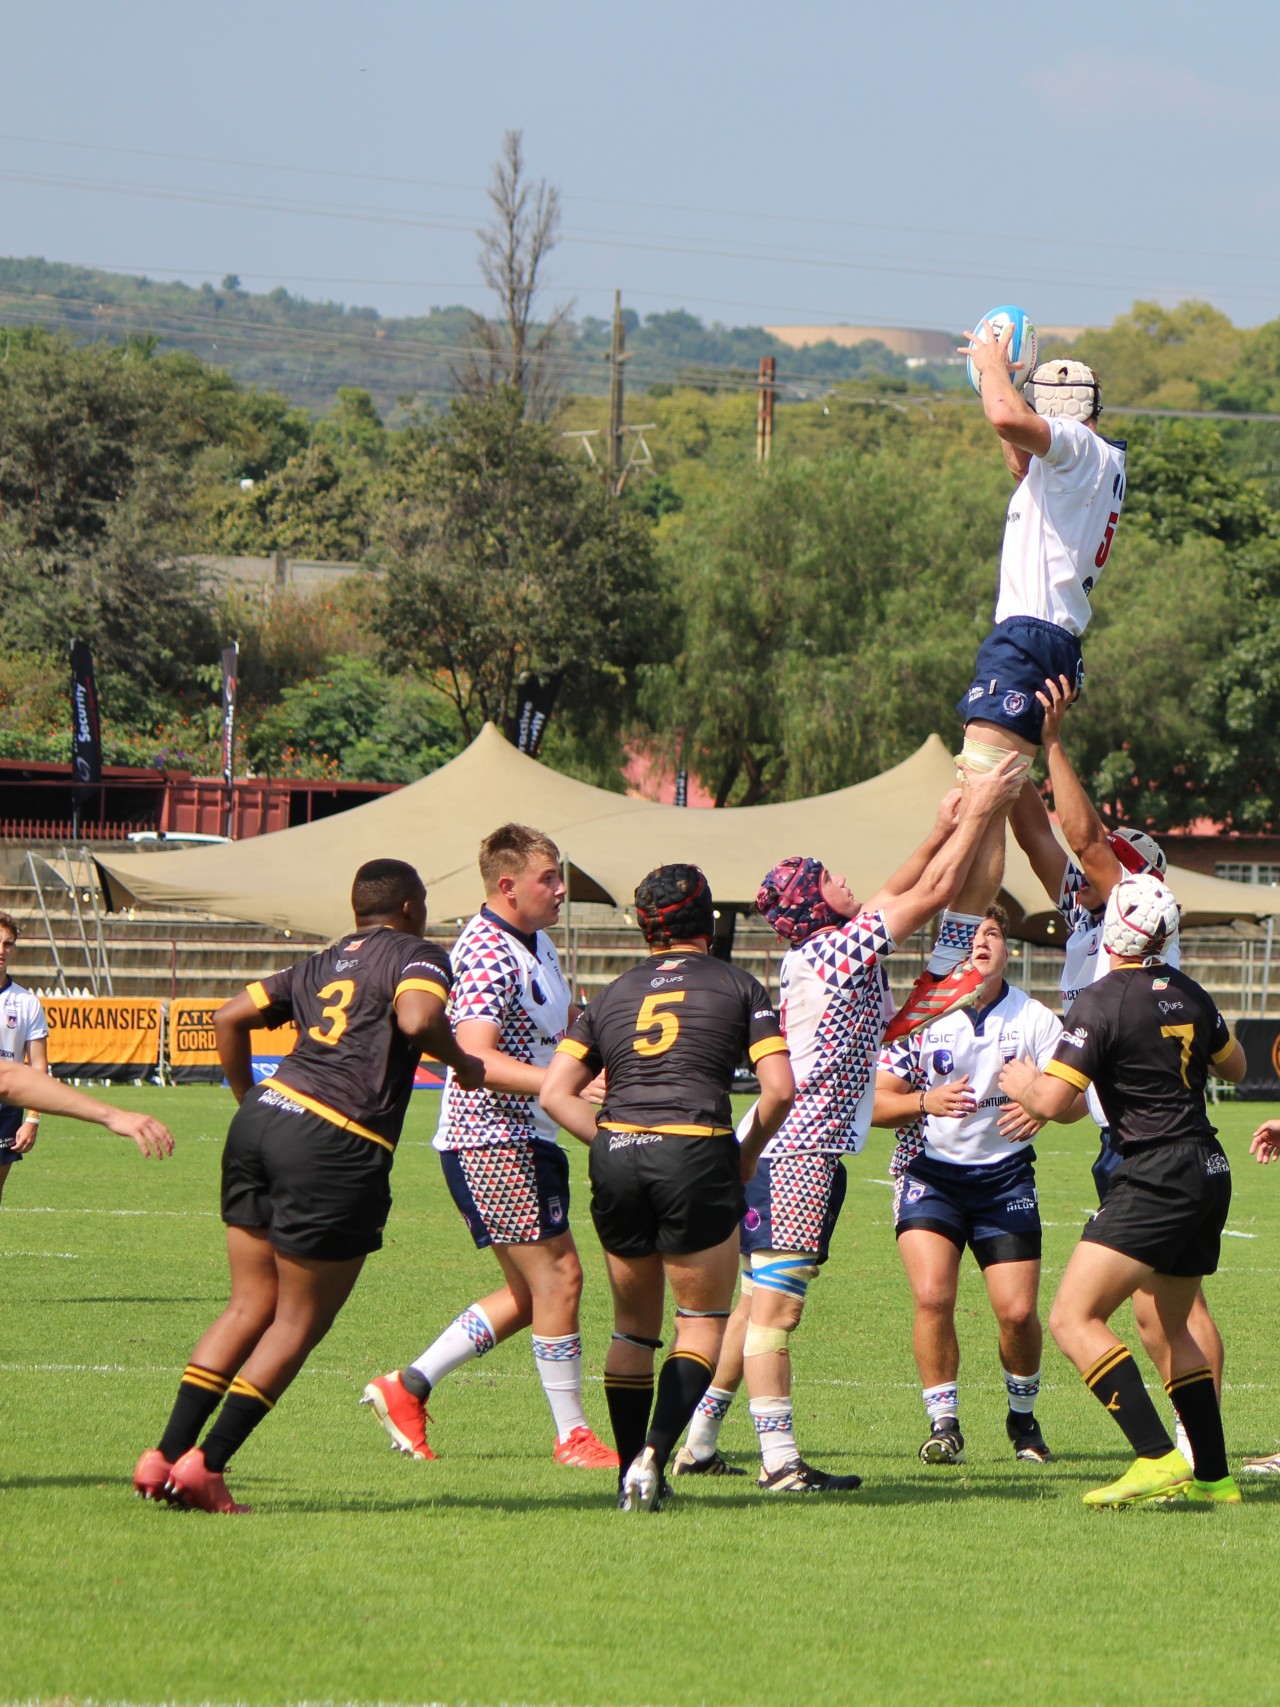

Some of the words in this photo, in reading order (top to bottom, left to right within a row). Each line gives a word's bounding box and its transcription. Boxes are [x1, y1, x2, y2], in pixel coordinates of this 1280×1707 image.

[77, 683, 92, 743] Security
[518, 701, 533, 752] ractive
[665, 975, 684, 984] UFS
[308, 979, 355, 1046] 3
[1169, 1001, 1184, 1010] UFS
[180, 1012, 214, 1025] ATK
[632, 990, 686, 1057] 5
[180, 1031, 217, 1050] OORD
[1160, 1023, 1195, 1090] 7
[609, 1135, 663, 1152] PROTECTA
[1007, 1202, 1034, 1212] HILUX
